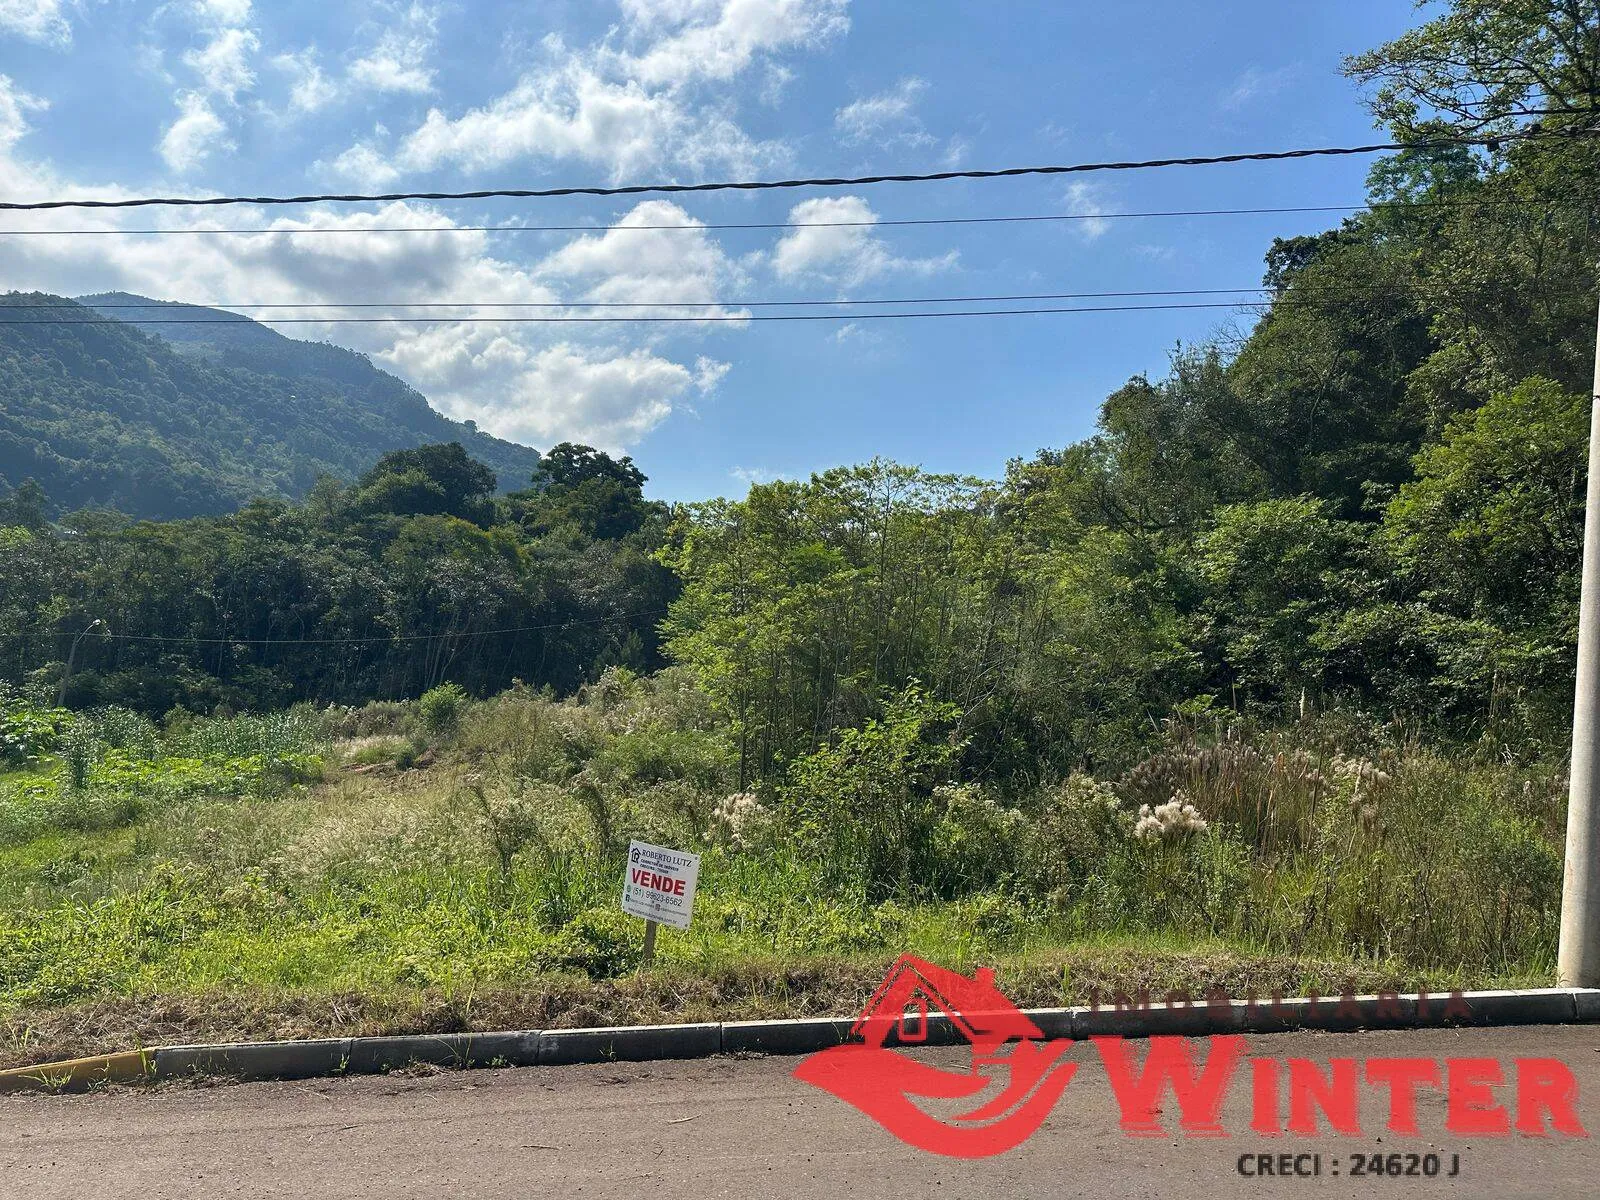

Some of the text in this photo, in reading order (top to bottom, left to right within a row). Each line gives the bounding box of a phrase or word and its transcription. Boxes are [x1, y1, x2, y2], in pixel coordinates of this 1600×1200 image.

[642, 849, 692, 868] ROBERTO LUTZ
[632, 868, 686, 896] VENDE
[633, 887, 644, 898] (51)
